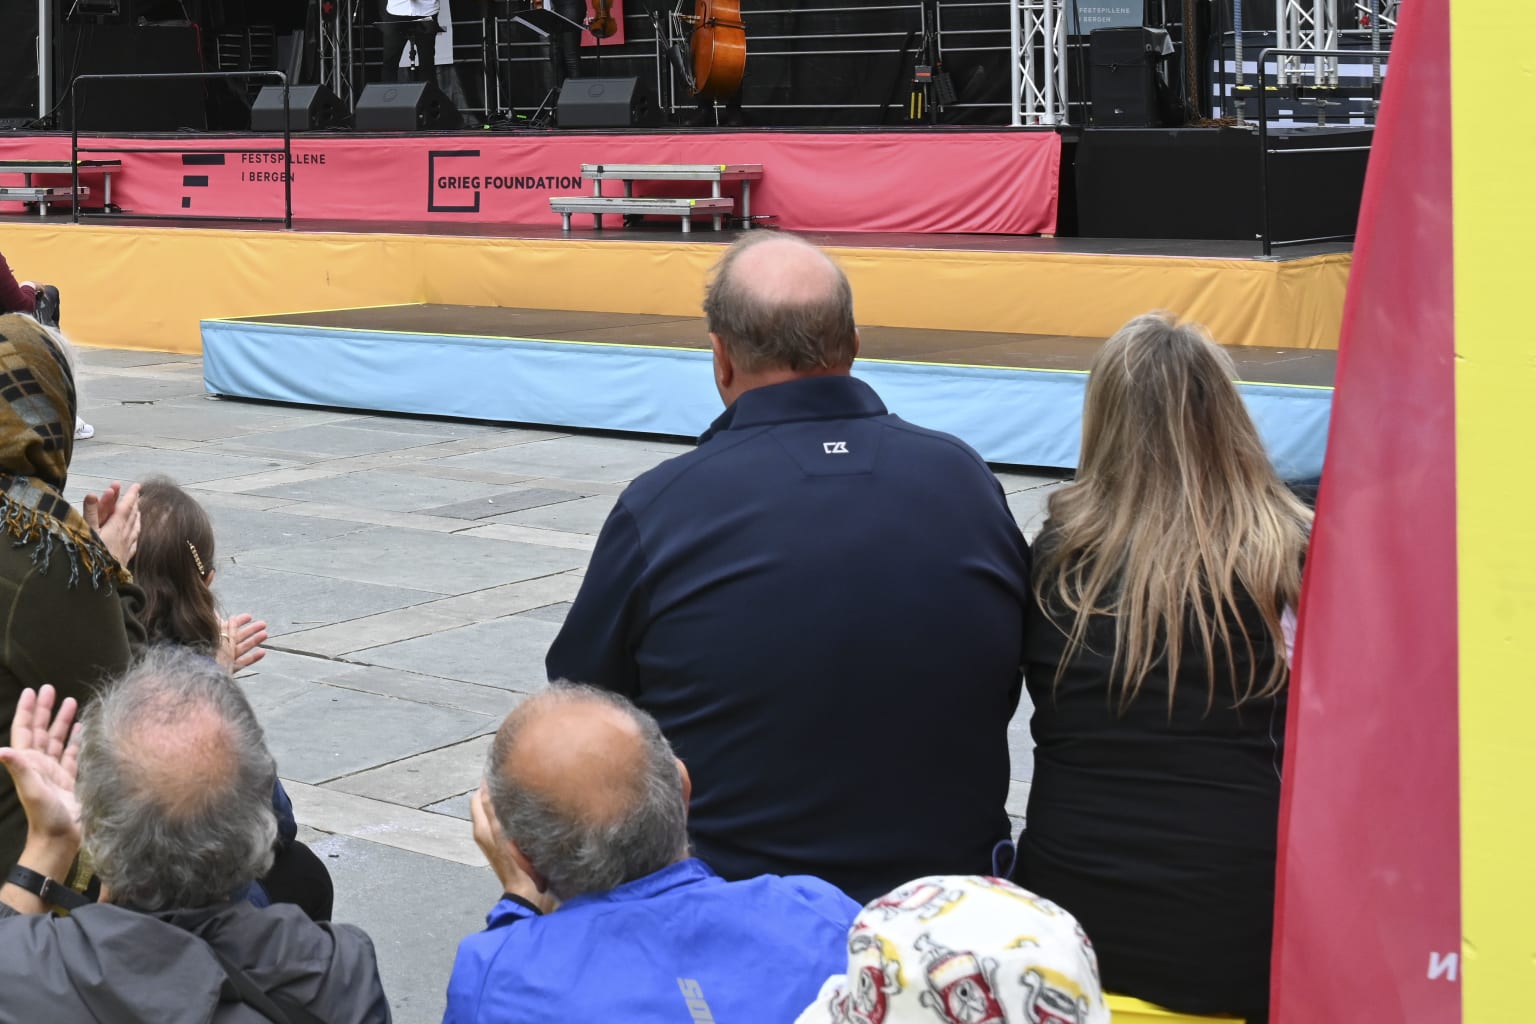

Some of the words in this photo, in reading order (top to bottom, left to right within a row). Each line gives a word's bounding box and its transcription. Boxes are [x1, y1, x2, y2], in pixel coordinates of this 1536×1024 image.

[241, 153, 326, 165] FESTSPLLENE
[437, 176, 481, 189] GRIEG
[484, 176, 582, 189] FOUNDATION
